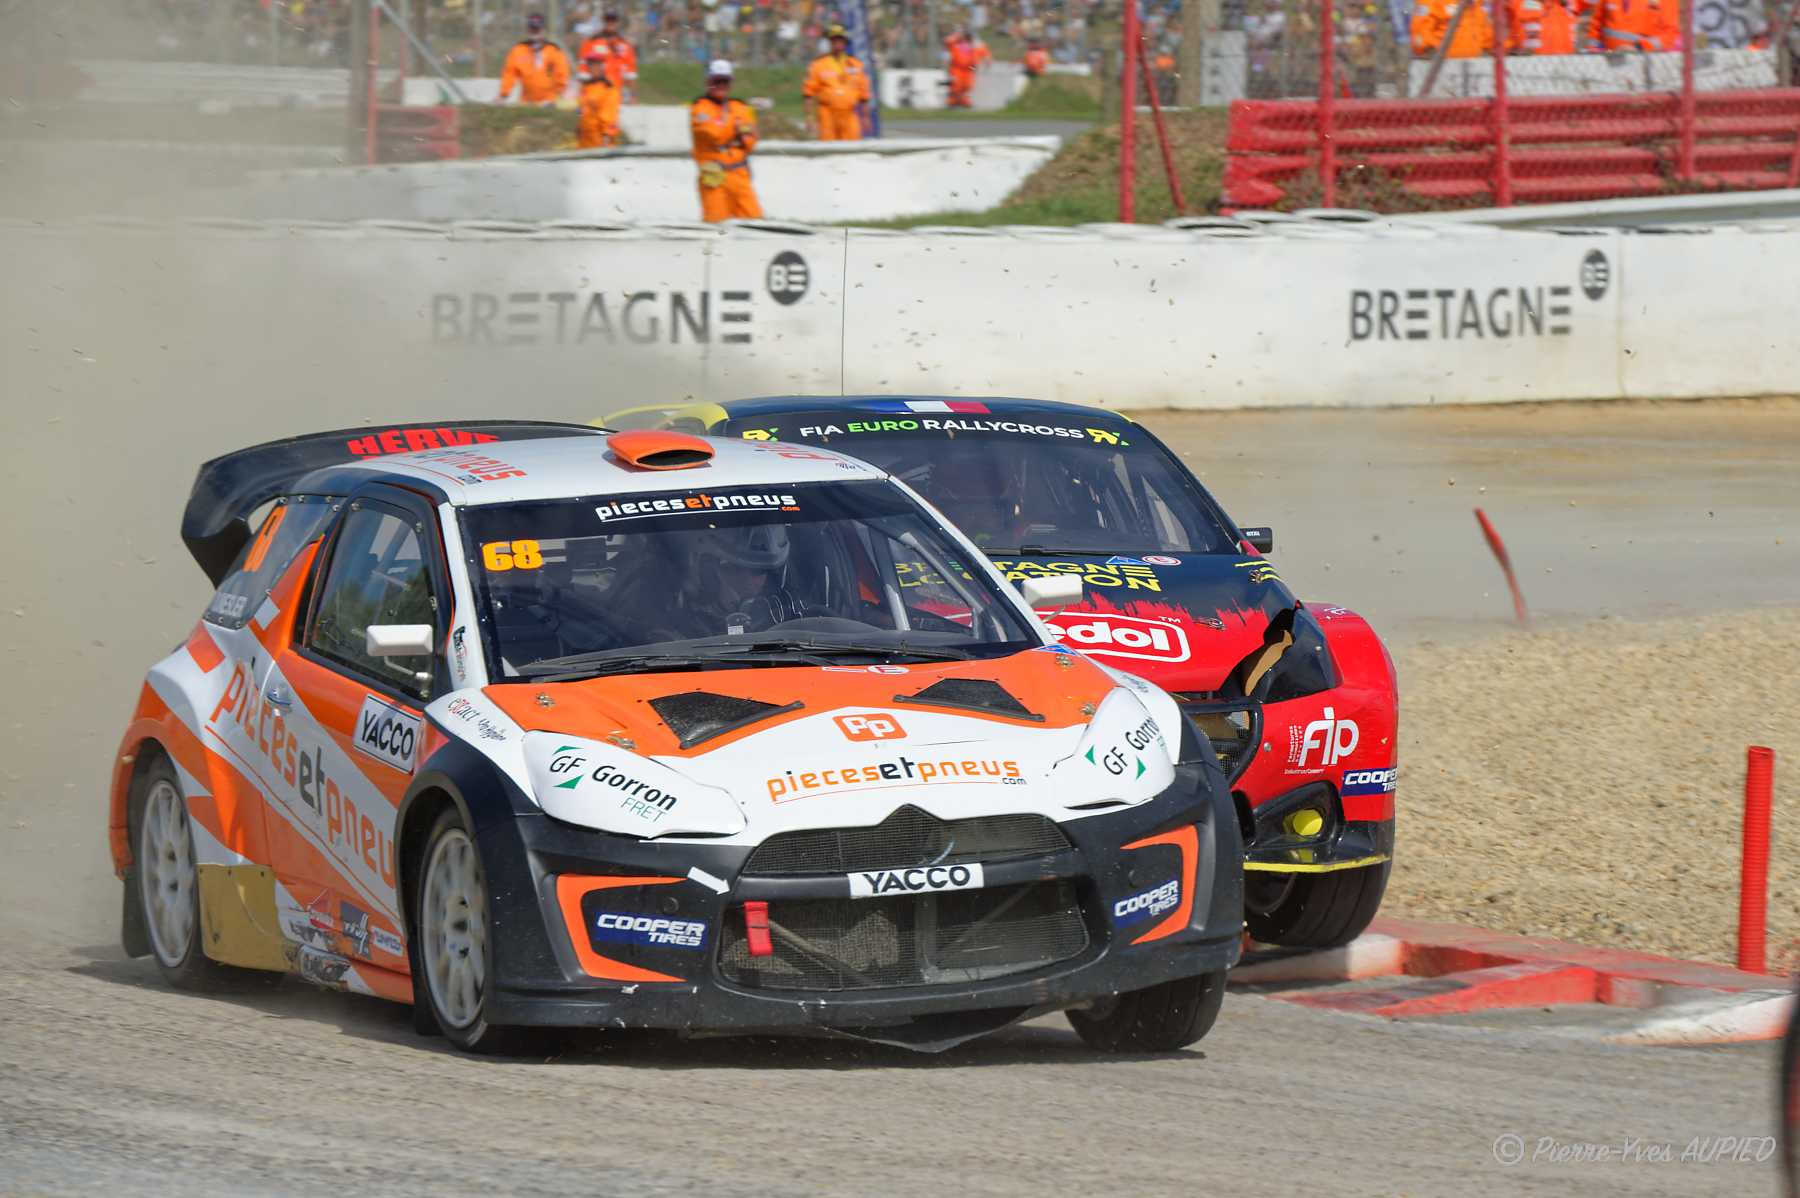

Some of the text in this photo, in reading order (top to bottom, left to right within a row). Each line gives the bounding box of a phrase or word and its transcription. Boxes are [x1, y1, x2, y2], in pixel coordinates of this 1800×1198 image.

[432, 290, 752, 344] BRETAGNE
[1350, 286, 1572, 341] BRETAGNE
[800, 425, 844, 437] FIA
[847, 420, 918, 433] EURO
[922, 420, 1085, 439] RALLYCROSS
[595, 493, 796, 521] piecesetpneus
[482, 539, 543, 571] 68
[1045, 621, 1170, 651] edol
[362, 710, 414, 760] YACCO
[210, 658, 395, 878] piecesetpneu
[1103, 746, 1128, 775] GF
[549, 755, 678, 811] GF Gorron
[767, 757, 1020, 802] piecesetpneus
[1344, 768, 1397, 785] COOPE
[621, 797, 667, 823] FRET
[862, 865, 971, 895] YACCO
[1114, 880, 1179, 917] COOPER
[1148, 894, 1179, 916] TIRES
[597, 914, 706, 937] COOPER
[648, 932, 702, 946] TIRES
